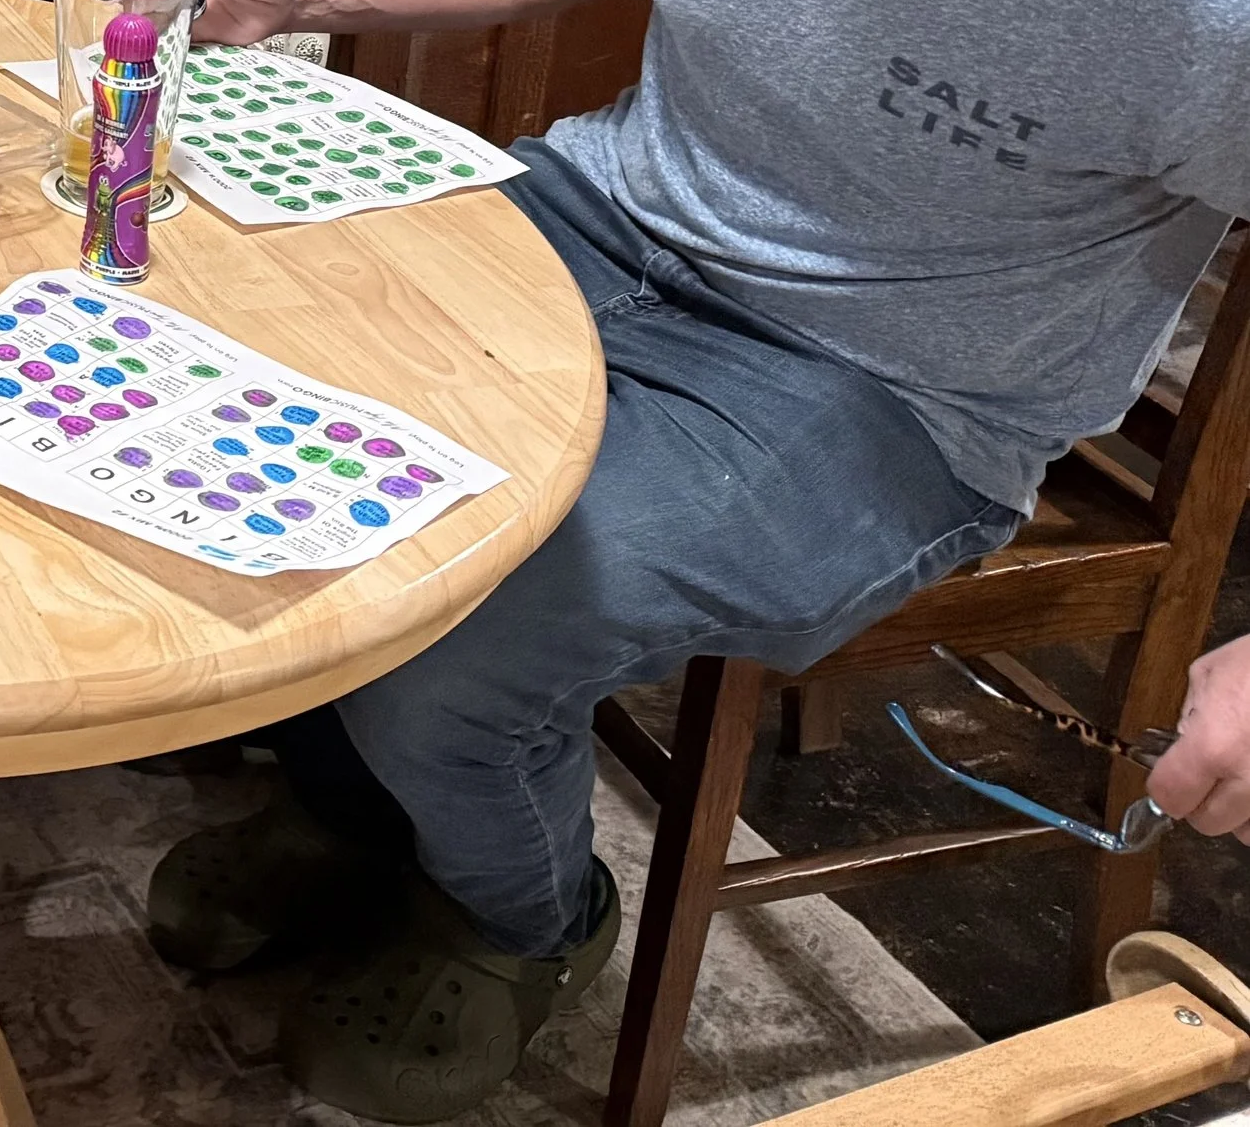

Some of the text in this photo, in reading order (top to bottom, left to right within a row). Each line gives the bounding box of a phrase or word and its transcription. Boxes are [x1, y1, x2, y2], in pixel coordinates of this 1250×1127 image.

[887, 57, 1045, 141] SALT
[32, 437, 57, 452] B
[90, 468, 114, 480] O
[130, 489, 155, 503] G
[171, 510, 199, 524] N
